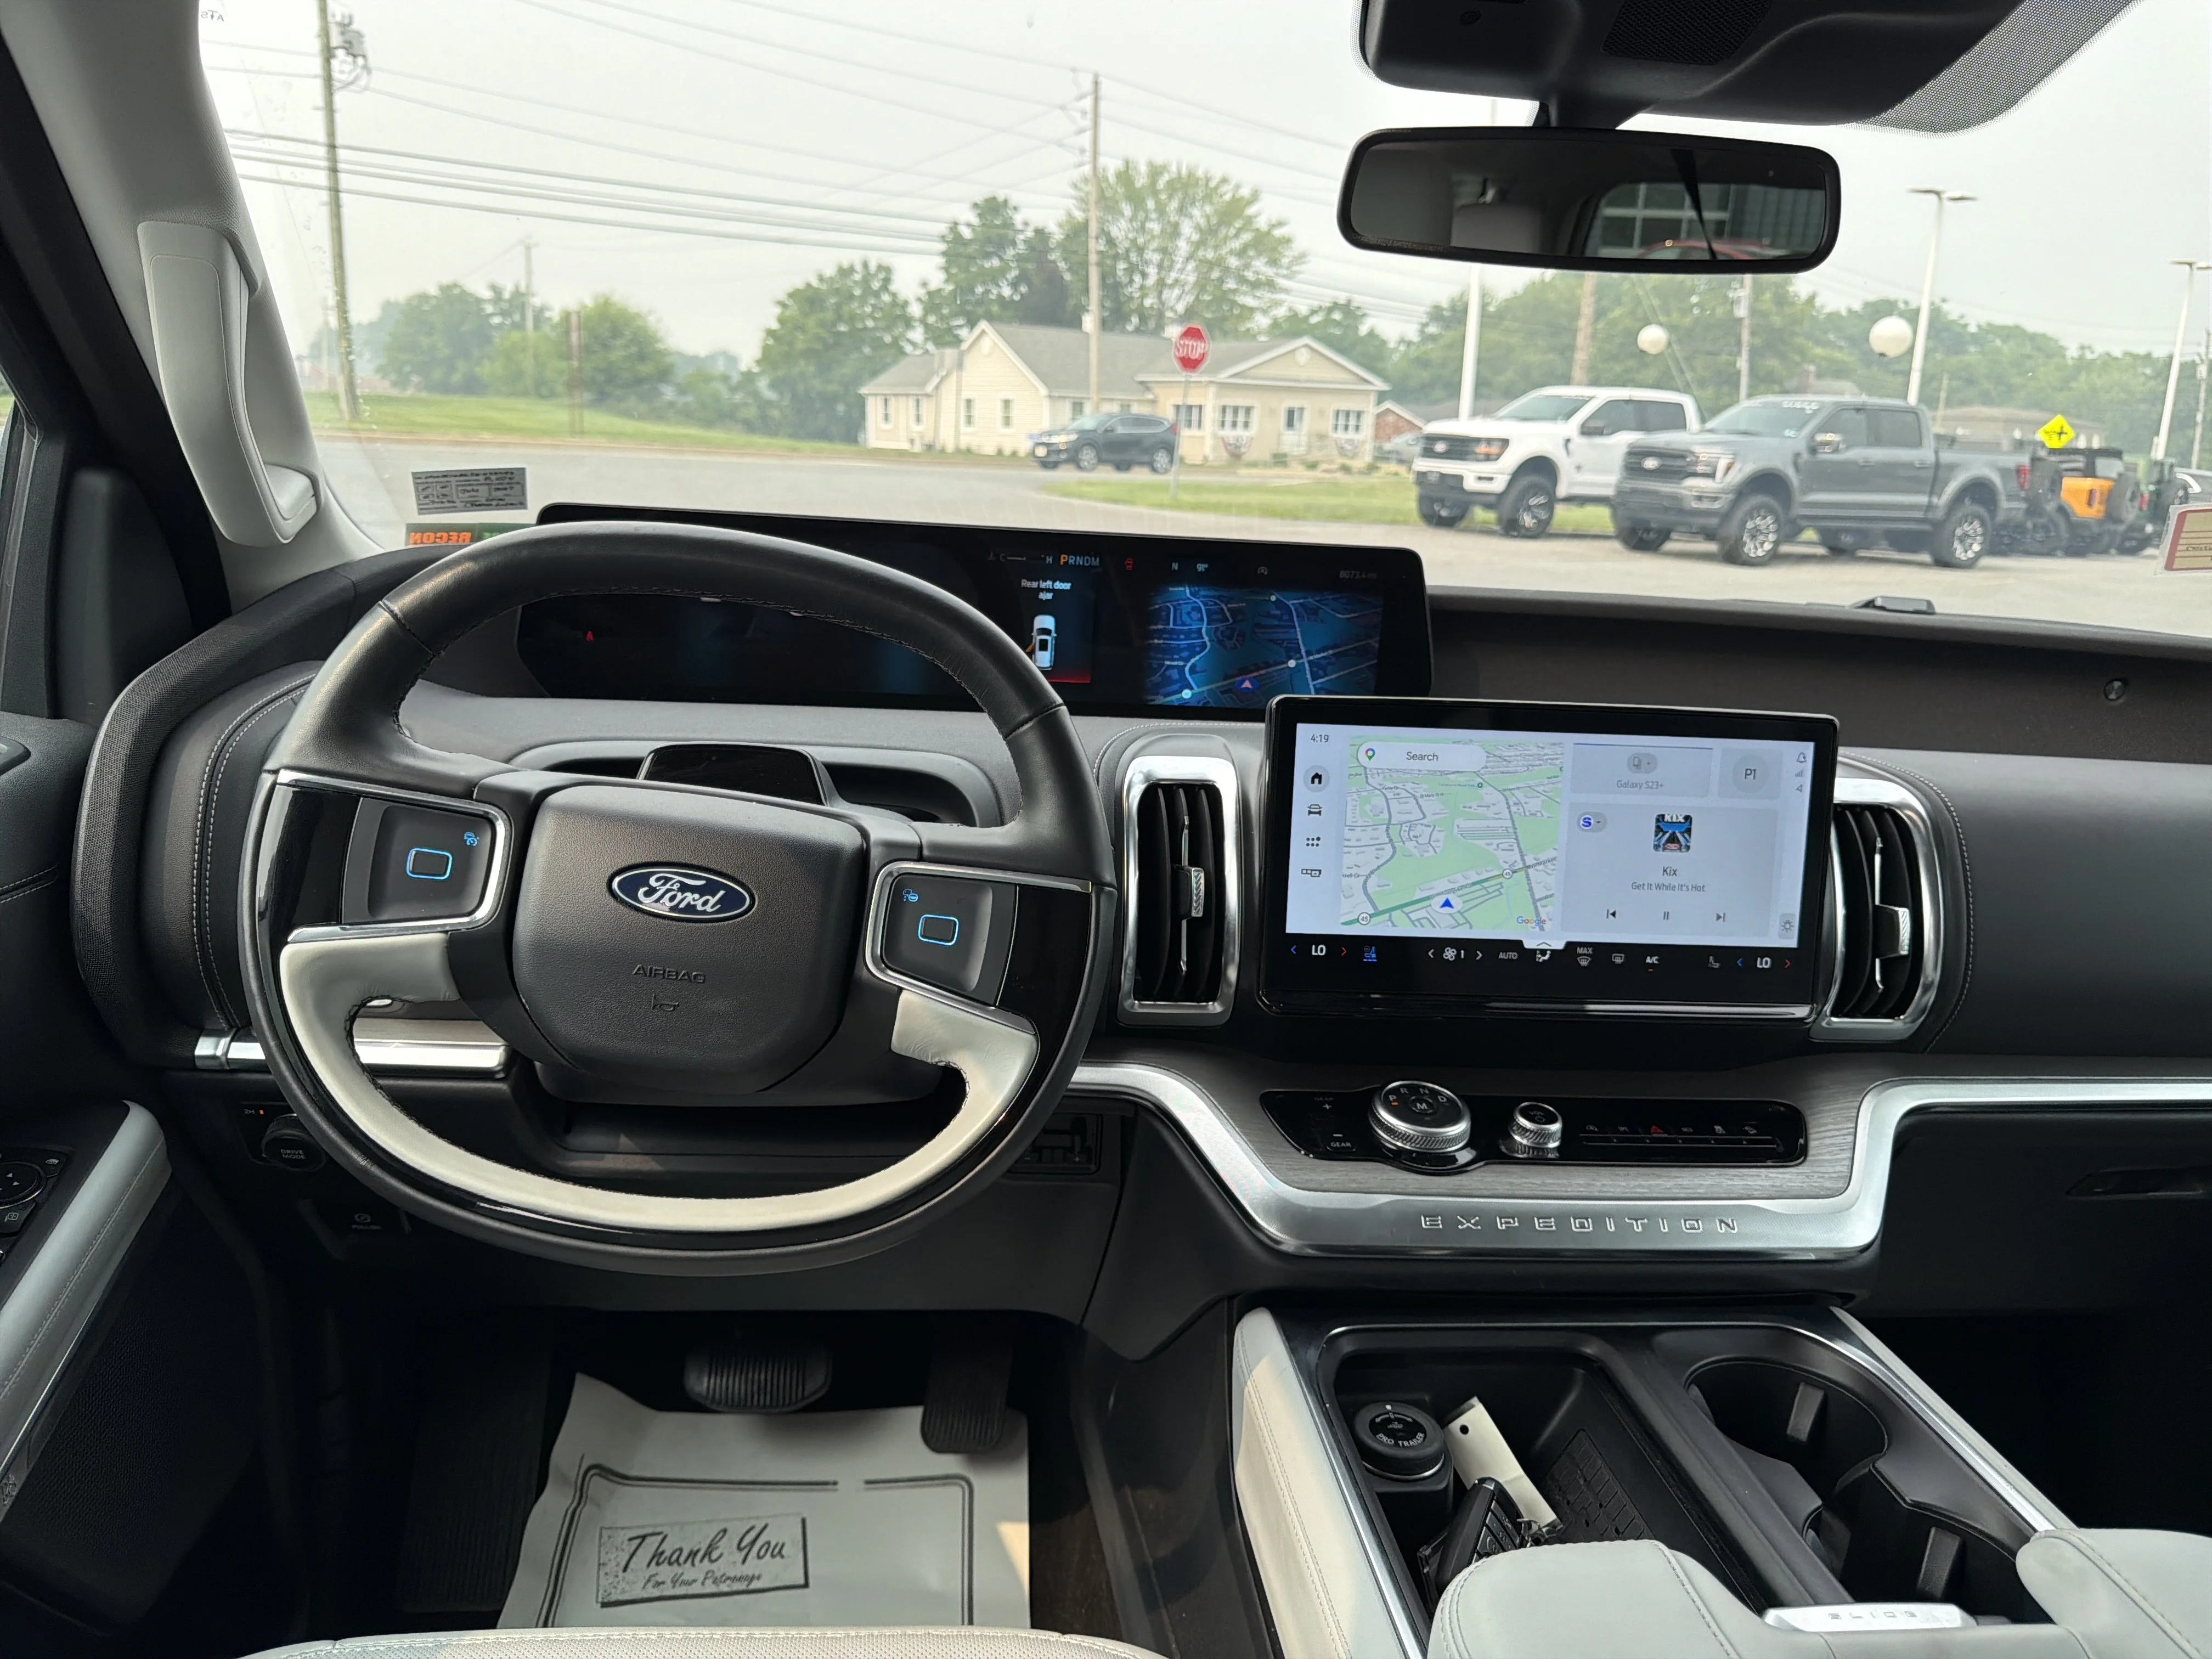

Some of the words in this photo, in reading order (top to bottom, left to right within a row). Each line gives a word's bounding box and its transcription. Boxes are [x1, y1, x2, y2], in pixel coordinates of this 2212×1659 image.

[1176, 339, 1206, 360] STOP
[1171, 562, 1179, 571] N
[1021, 579, 1039, 588] Rear
[1040, 579, 1053, 590] left
[1053, 580, 1072, 590] door
[1038, 591, 1054, 601] ajar
[1311, 734, 1329, 743] 4:19
[1406, 751, 1438, 761] Search
[1745, 768, 1757, 780] P1
[1616, 780, 1643, 789] Galaxy
[1645, 781, 1663, 789] S23+
[1662, 866, 1678, 877] Kix
[637, 872, 726, 913] Ford
[1631, 882, 1645, 891] Get
[1646, 882, 1652, 890] It
[1654, 882, 1676, 892] While
[1677, 883, 1690, 892] It's
[1691, 884, 1705, 893] Hot
[1516, 916, 1547, 927] Google
[1311, 945, 1327, 956] LO
[1498, 951, 1519, 960] AUTO
[1577, 946, 1592, 955] MAX
[1645, 956, 1660, 964] A/C
[1757, 957, 1771, 968] LO
[631, 963, 707, 985] AIRBAG
[1421, 1215, 1739, 1234] EXPEDITION
[1376, 1432, 1394, 1444] PRO
[1397, 1432, 1425, 1447] TRAILER
[622, 1527, 729, 1573] Thank
[736, 1522, 785, 1565] You
[641, 1573, 667, 1590] For
[670, 1572, 698, 1589] Your
[701, 1569, 763, 1588] Patronage
